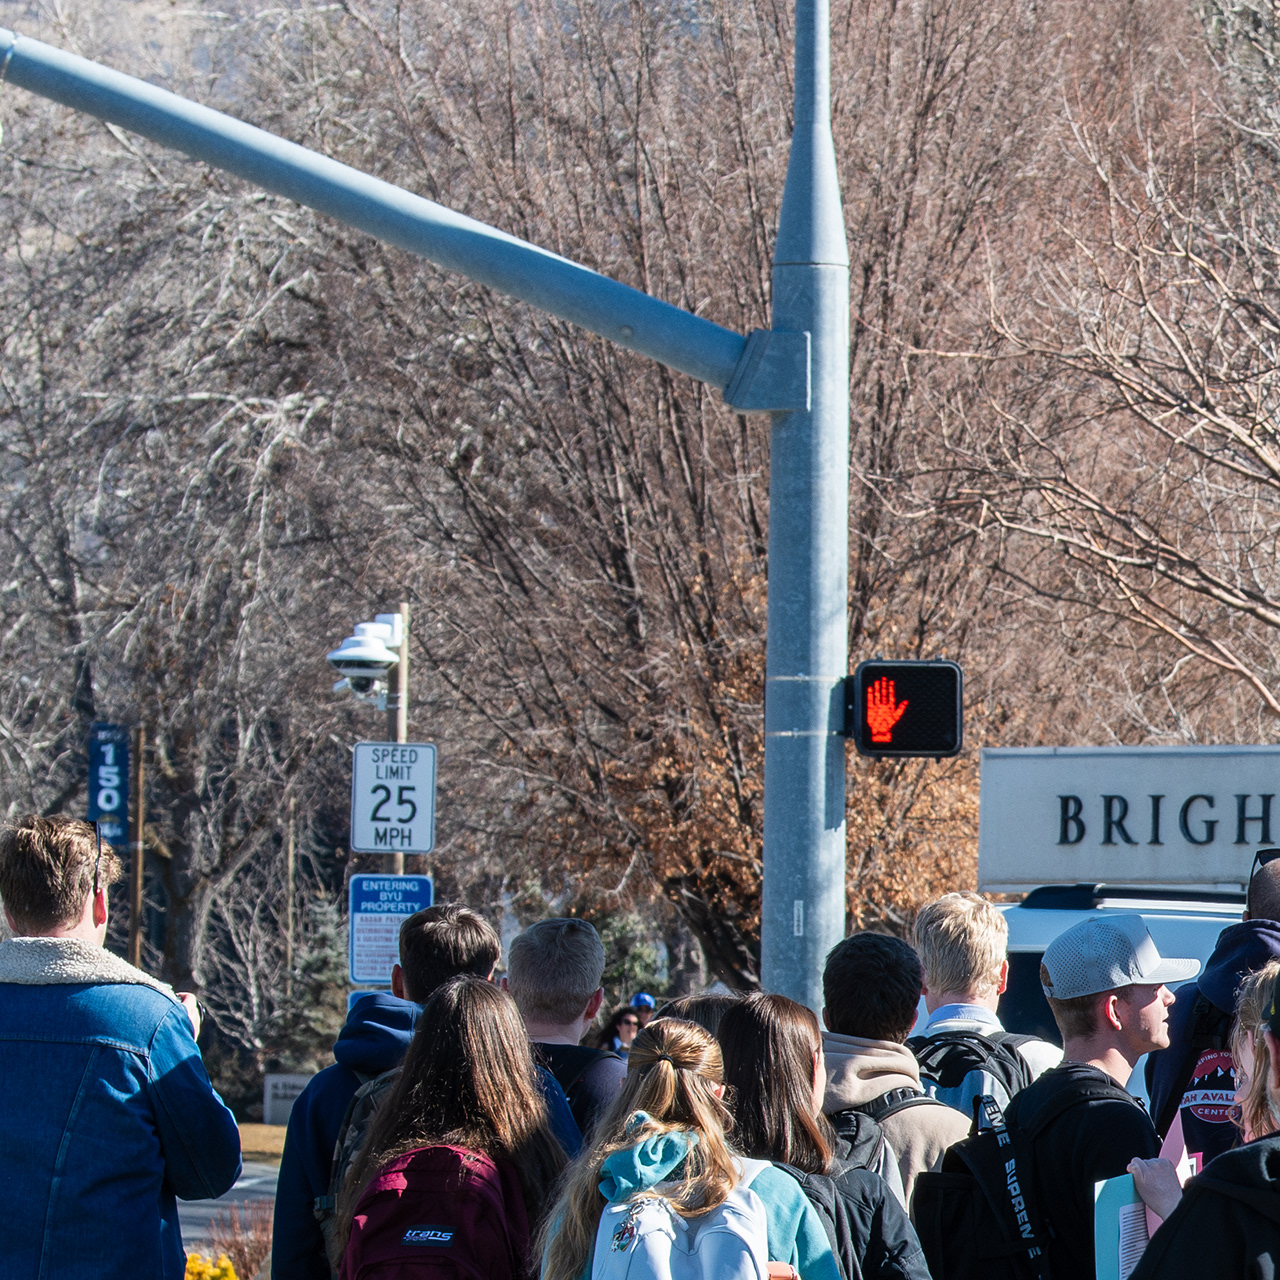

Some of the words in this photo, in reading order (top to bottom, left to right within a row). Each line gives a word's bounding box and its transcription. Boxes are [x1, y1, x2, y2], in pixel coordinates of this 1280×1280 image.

[371, 748, 418, 764] SPEED
[376, 765, 412, 780] LIMIT
[370, 783, 417, 824] 25
[374, 827, 412, 847] MPH
[362, 880, 420, 891] ENTERING
[379, 891, 403, 901] BYU
[361, 902, 421, 912] PROPERTY
[1197, 1107, 1236, 1116] CENTER
[405, 1229, 453, 1241] trans
